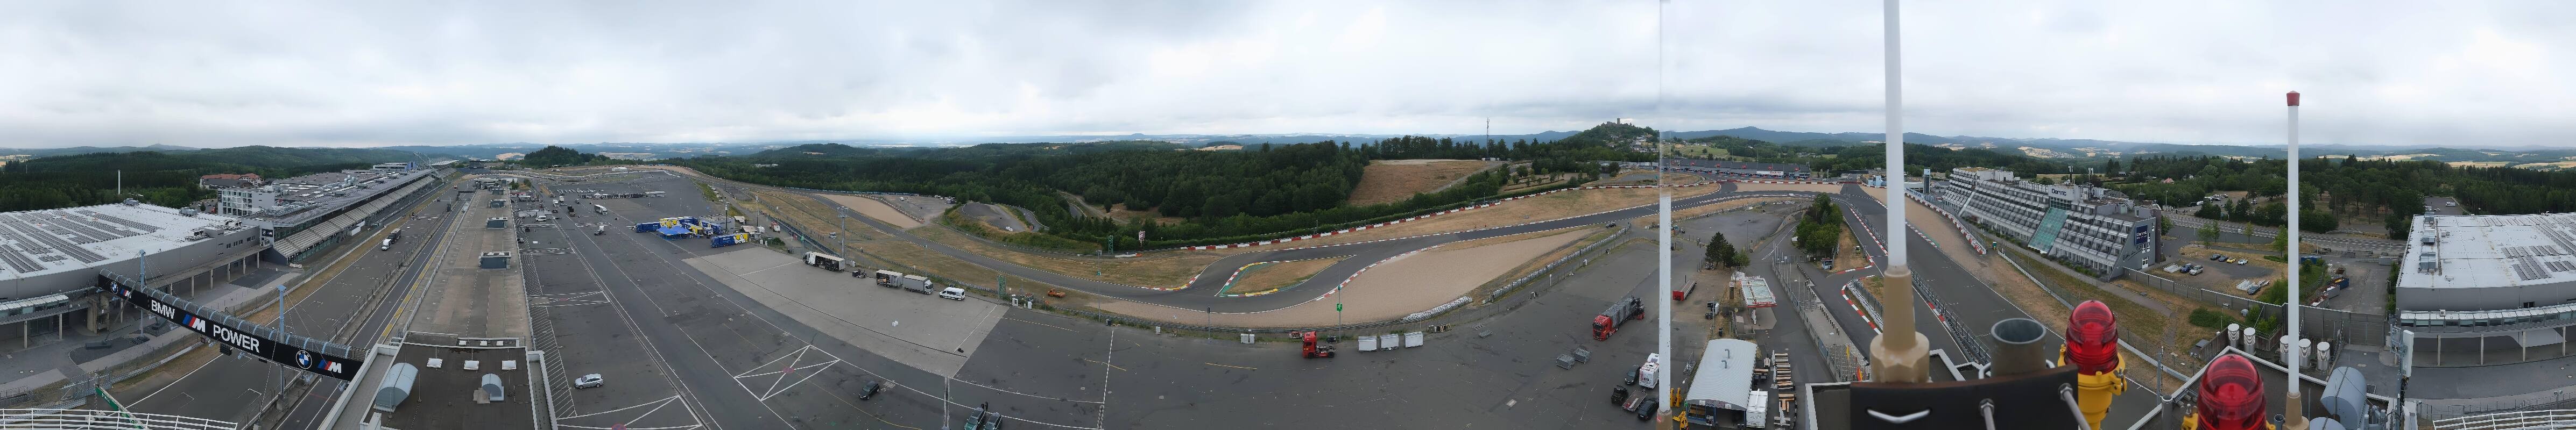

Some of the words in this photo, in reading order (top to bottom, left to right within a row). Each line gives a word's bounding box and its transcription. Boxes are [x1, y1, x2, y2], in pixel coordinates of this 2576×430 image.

[2051, 188, 2067, 196] Dorint
[151, 299, 175, 319] BMW
[213, 324, 260, 353] POWER
